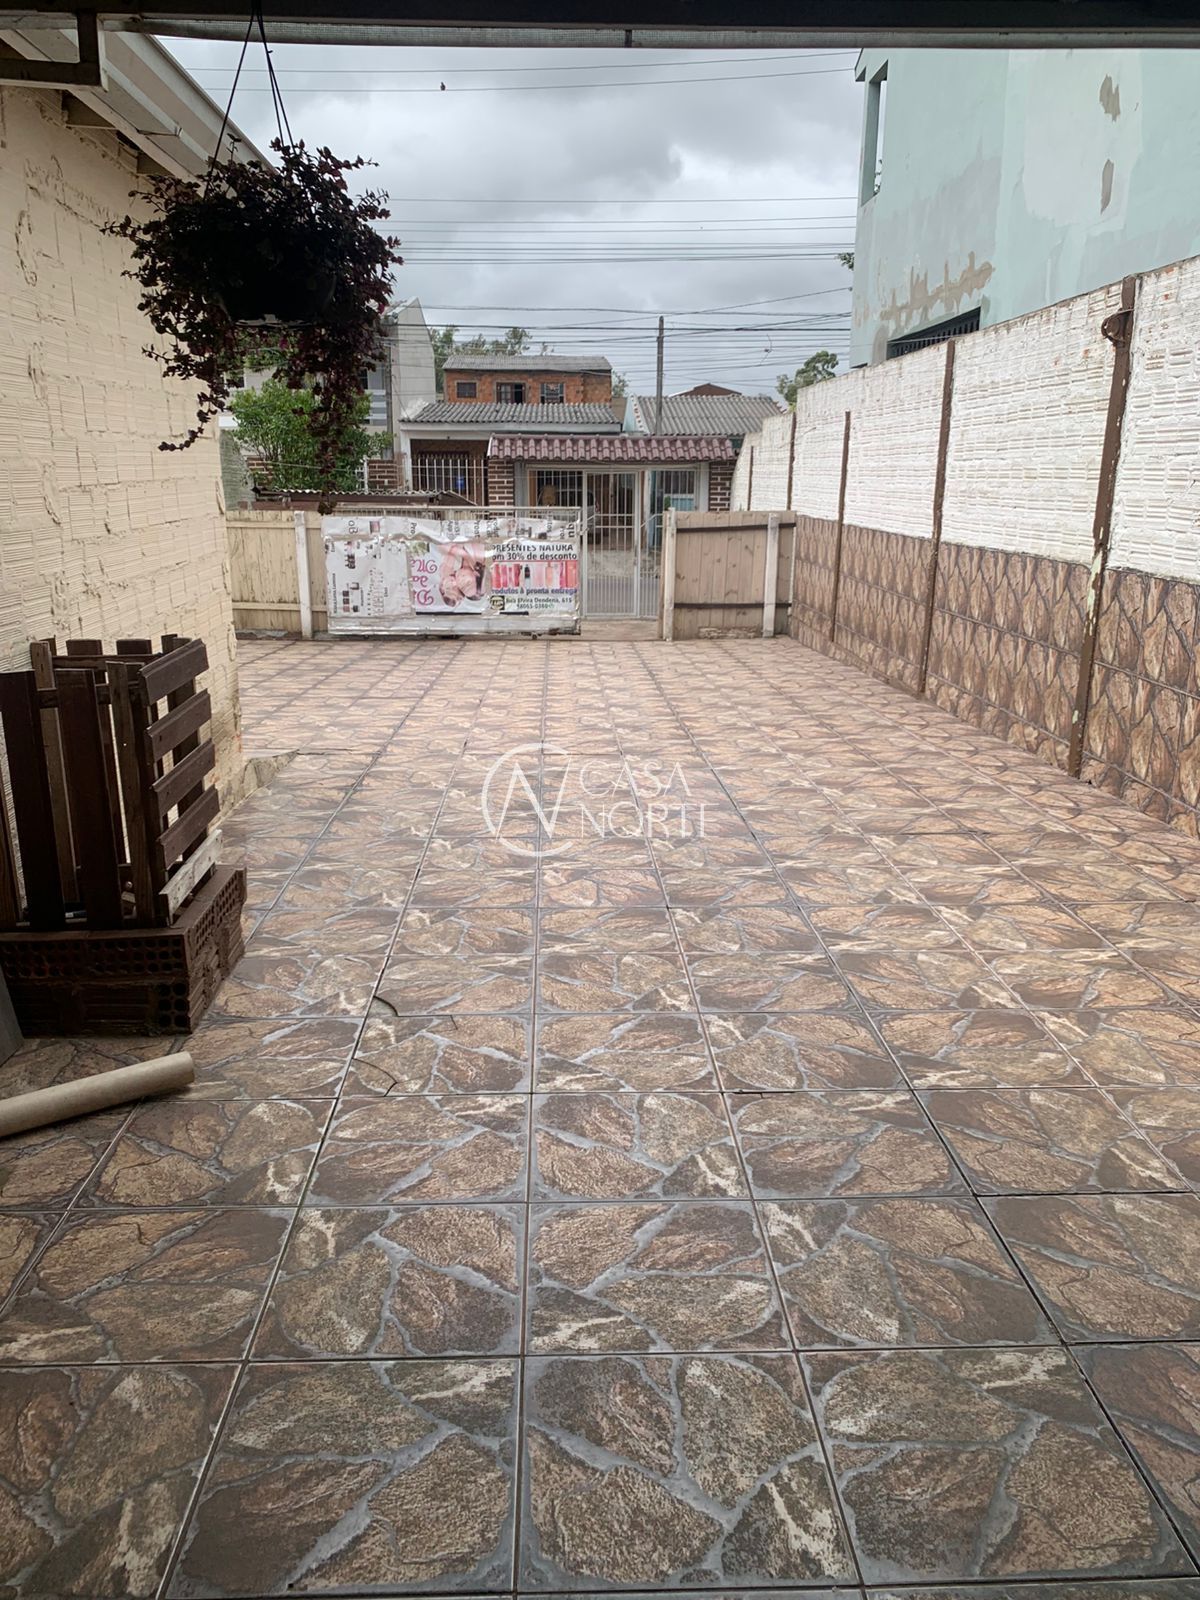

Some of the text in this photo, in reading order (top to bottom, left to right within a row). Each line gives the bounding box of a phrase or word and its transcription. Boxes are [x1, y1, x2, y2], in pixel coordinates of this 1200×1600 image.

[526, 552, 537, 560] de
[540, 552, 577, 560] desconto
[551, 588, 577, 596] entrega
